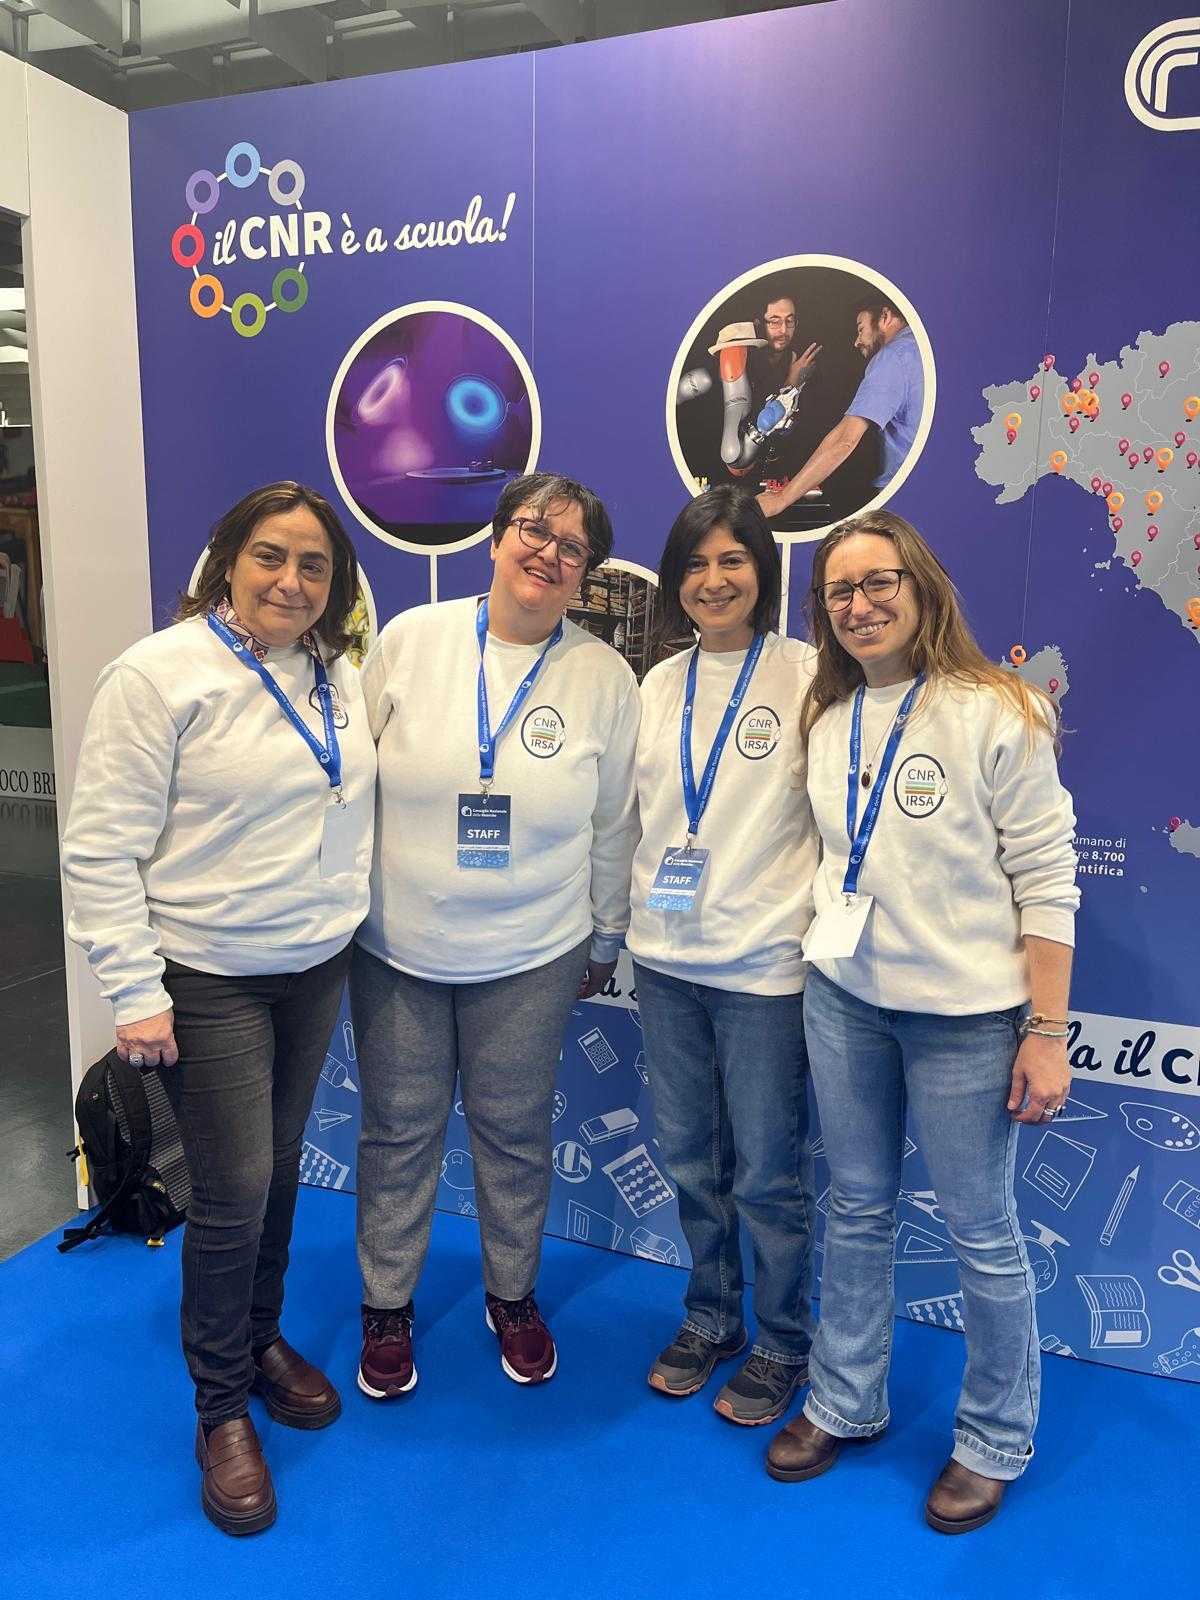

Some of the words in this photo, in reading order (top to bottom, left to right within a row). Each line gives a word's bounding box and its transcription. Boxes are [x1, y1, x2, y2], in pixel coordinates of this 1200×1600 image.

[212, 219, 237, 266] il
[239, 210, 333, 260] CNR
[340, 212, 361, 255] è
[365, 227, 387, 253] a
[393, 192, 516, 251] scuola!
[533, 717, 557, 730] CNR
[748, 718, 773, 729] CNR
[530, 738, 555, 751] IRSA
[744, 740, 769, 751] IRSA
[907, 768, 936, 781] CNR
[905, 795, 934, 807] IRSA
[466, 829, 500, 839] STAFF
[1115, 838, 1126, 849] di
[1091, 851, 1125, 862] 8.700
[662, 875, 692, 885] STAFF
[1113, 1030, 1156, 1078] il
[1160, 1048, 1200, 1086] C
